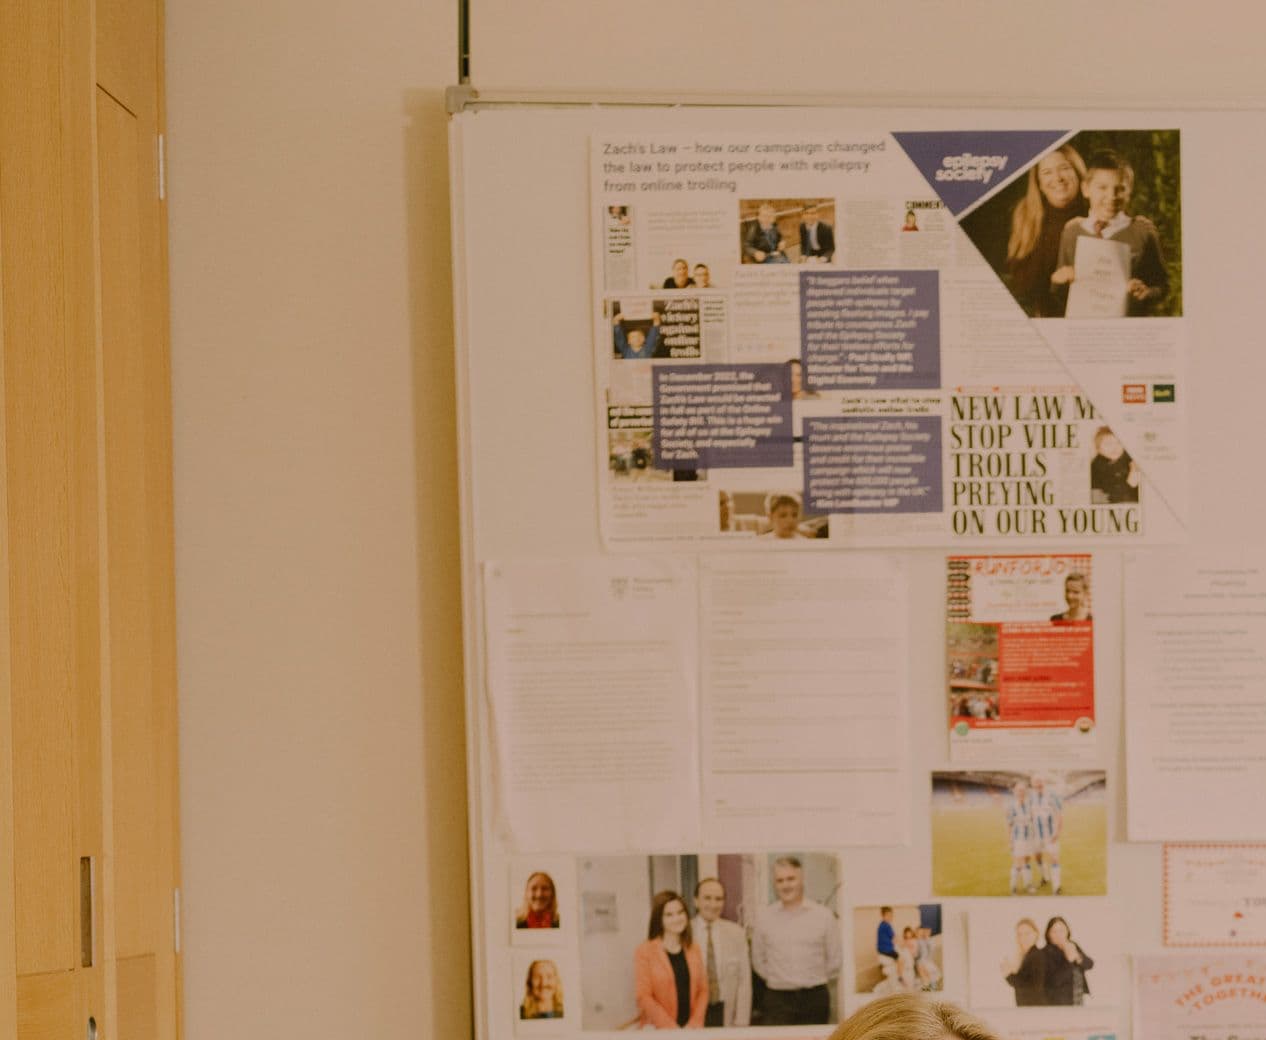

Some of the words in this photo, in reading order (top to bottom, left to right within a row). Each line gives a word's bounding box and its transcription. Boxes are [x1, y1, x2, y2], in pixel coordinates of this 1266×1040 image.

[603, 142, 646, 156] Zach's
[650, 142, 677, 154] Law
[695, 141, 723, 153] how
[728, 143, 750, 152] our
[754, 142, 822, 157] campaign
[827, 141, 886, 154] changed
[603, 160, 624, 173] the
[629, 159, 652, 173] law
[658, 161, 671, 172] to
[675, 160, 723, 175] protect
[729, 159, 774, 175] people
[781, 159, 808, 171] with
[813, 157, 869, 174] epilepsy
[942, 153, 1008, 171] epilepsy
[603, 179, 636, 192] from
[640, 178, 682, 192] online
[687, 178, 737, 194] trolling
[935, 168, 993, 184] society
[951, 396, 1004, 421] NEW
[1015, 396, 1067, 420] LAW
[951, 424, 1012, 449] STOP
[1024, 424, 1080, 449] VILE
[953, 453, 1048, 478] TROLLS
[953, 481, 1055, 507] PREYING
[953, 509, 984, 535] ON
[997, 509, 1046, 534] OUR
[1058, 509, 1140, 534] YOUNG
